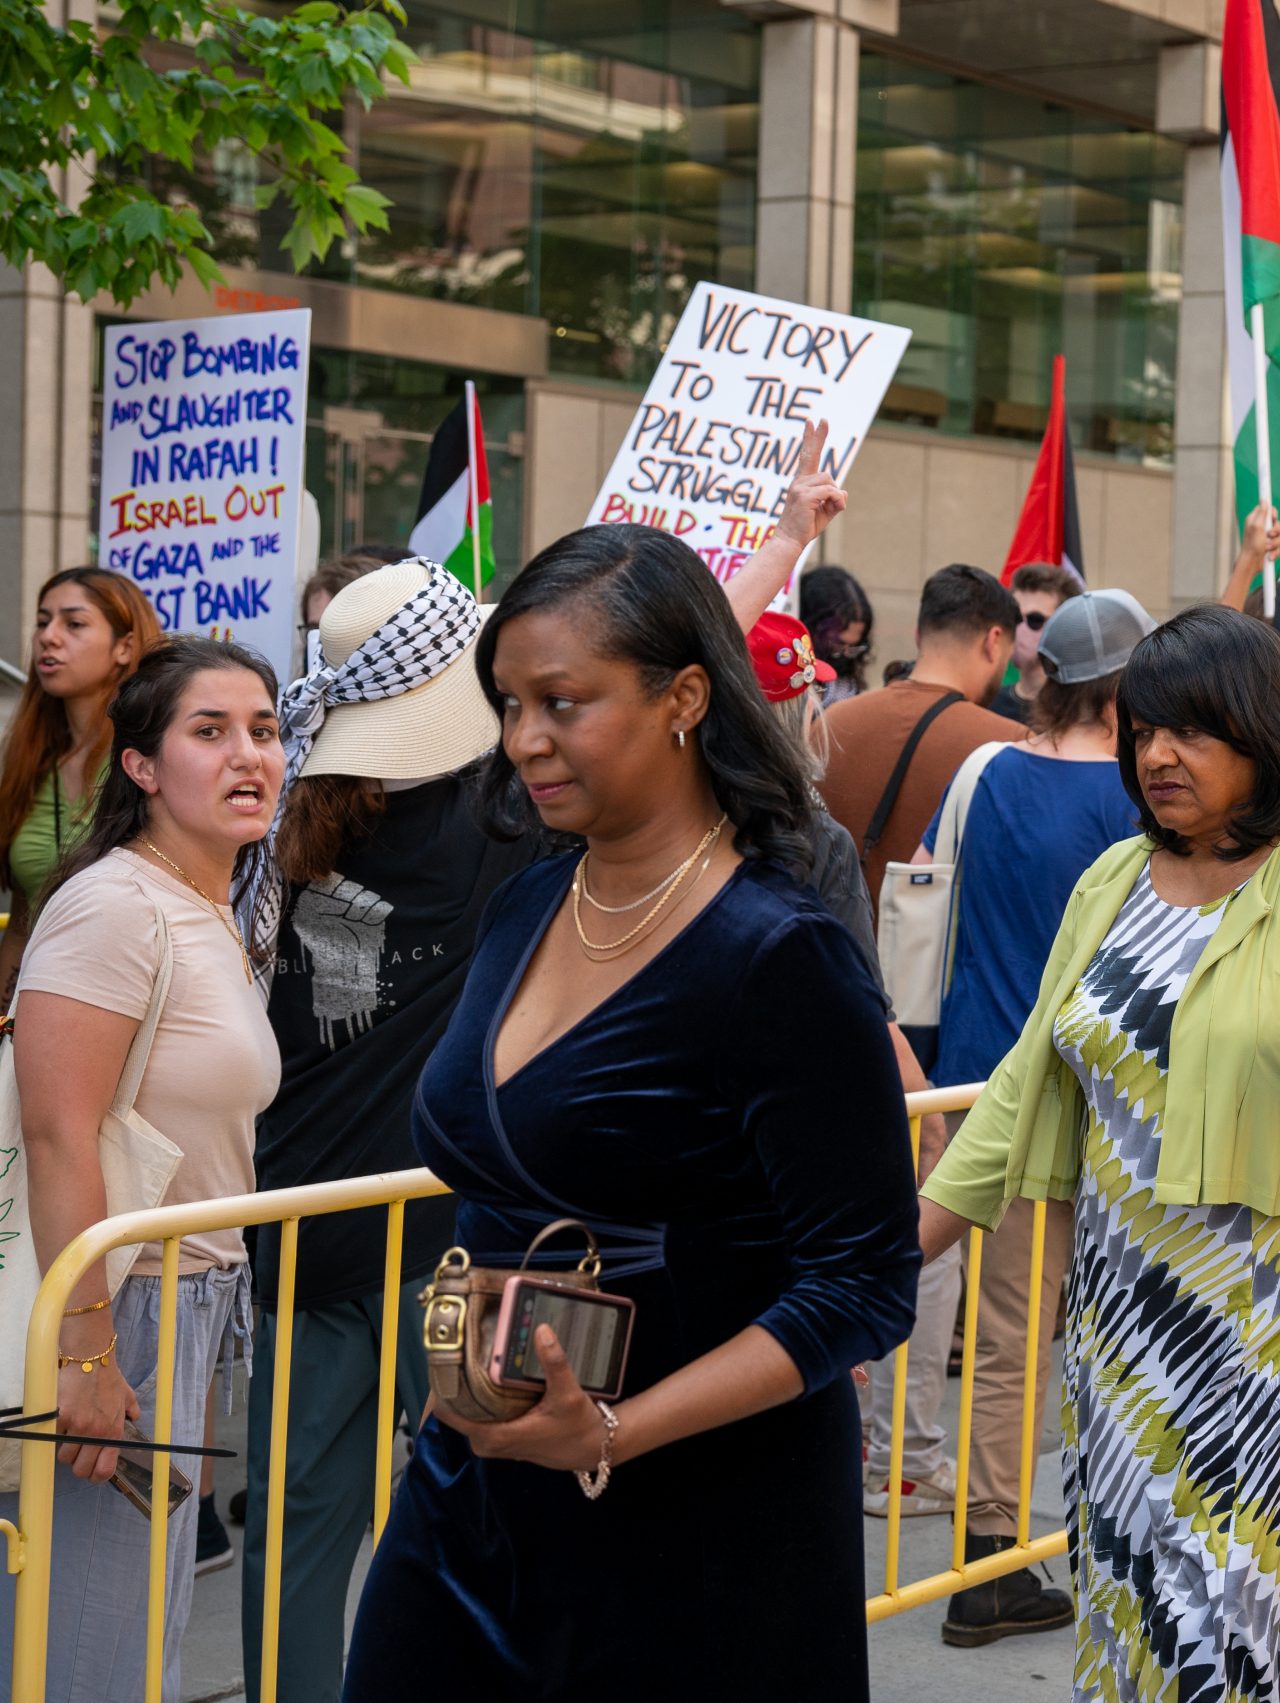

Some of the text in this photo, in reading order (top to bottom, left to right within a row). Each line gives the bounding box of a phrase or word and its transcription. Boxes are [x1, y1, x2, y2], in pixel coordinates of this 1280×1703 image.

[115, 330, 299, 389] STOP BOMBING
[698, 292, 873, 383] VICTORY
[110, 387, 294, 441] AND SLAUGHTER
[670, 360, 823, 422] TO THE
[132, 444, 159, 488] IN
[168, 436, 258, 483] RAFAH
[631, 404, 857, 482] PALESTININ
[108, 483, 286, 540] ISRAEL OUT
[600, 493, 698, 537] BUILD
[108, 531, 281, 582] OF GAZA AND THE
[194, 576, 272, 626] BANK
